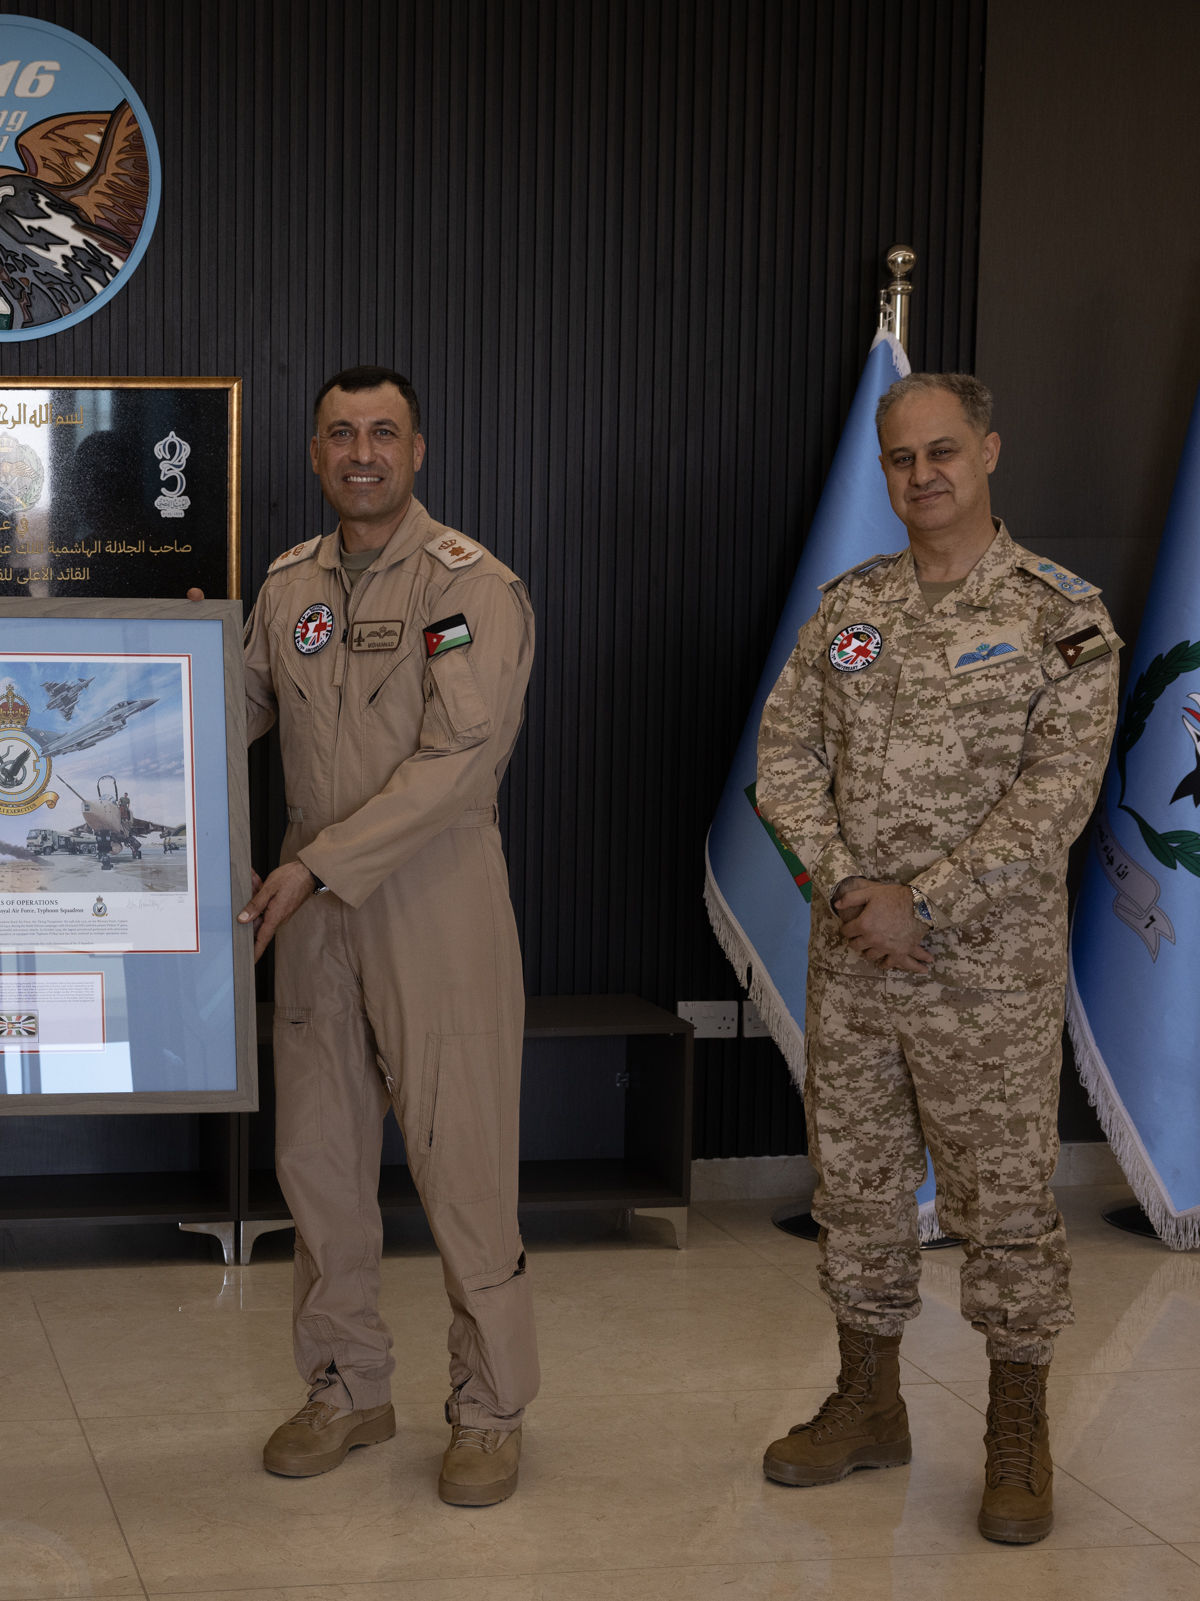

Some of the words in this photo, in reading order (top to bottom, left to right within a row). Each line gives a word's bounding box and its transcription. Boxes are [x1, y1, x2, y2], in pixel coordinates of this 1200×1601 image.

[29, 403, 53, 428] الله
[54, 405, 84, 428] بسم
[16, 512, 29, 538] في
[15, 540, 44, 554] الملك
[49, 540, 101, 557] الهاشمية
[105, 540, 145, 557] الجلالة
[149, 540, 192, 557] صاحب
[17, 566, 53, 584] الأعلى
[57, 567, 90, 581] القائد
[5, 802, 37, 814] EXERCITUS
[37, 907, 59, 915] Typhoon
[60, 907, 84, 915] Squadron
